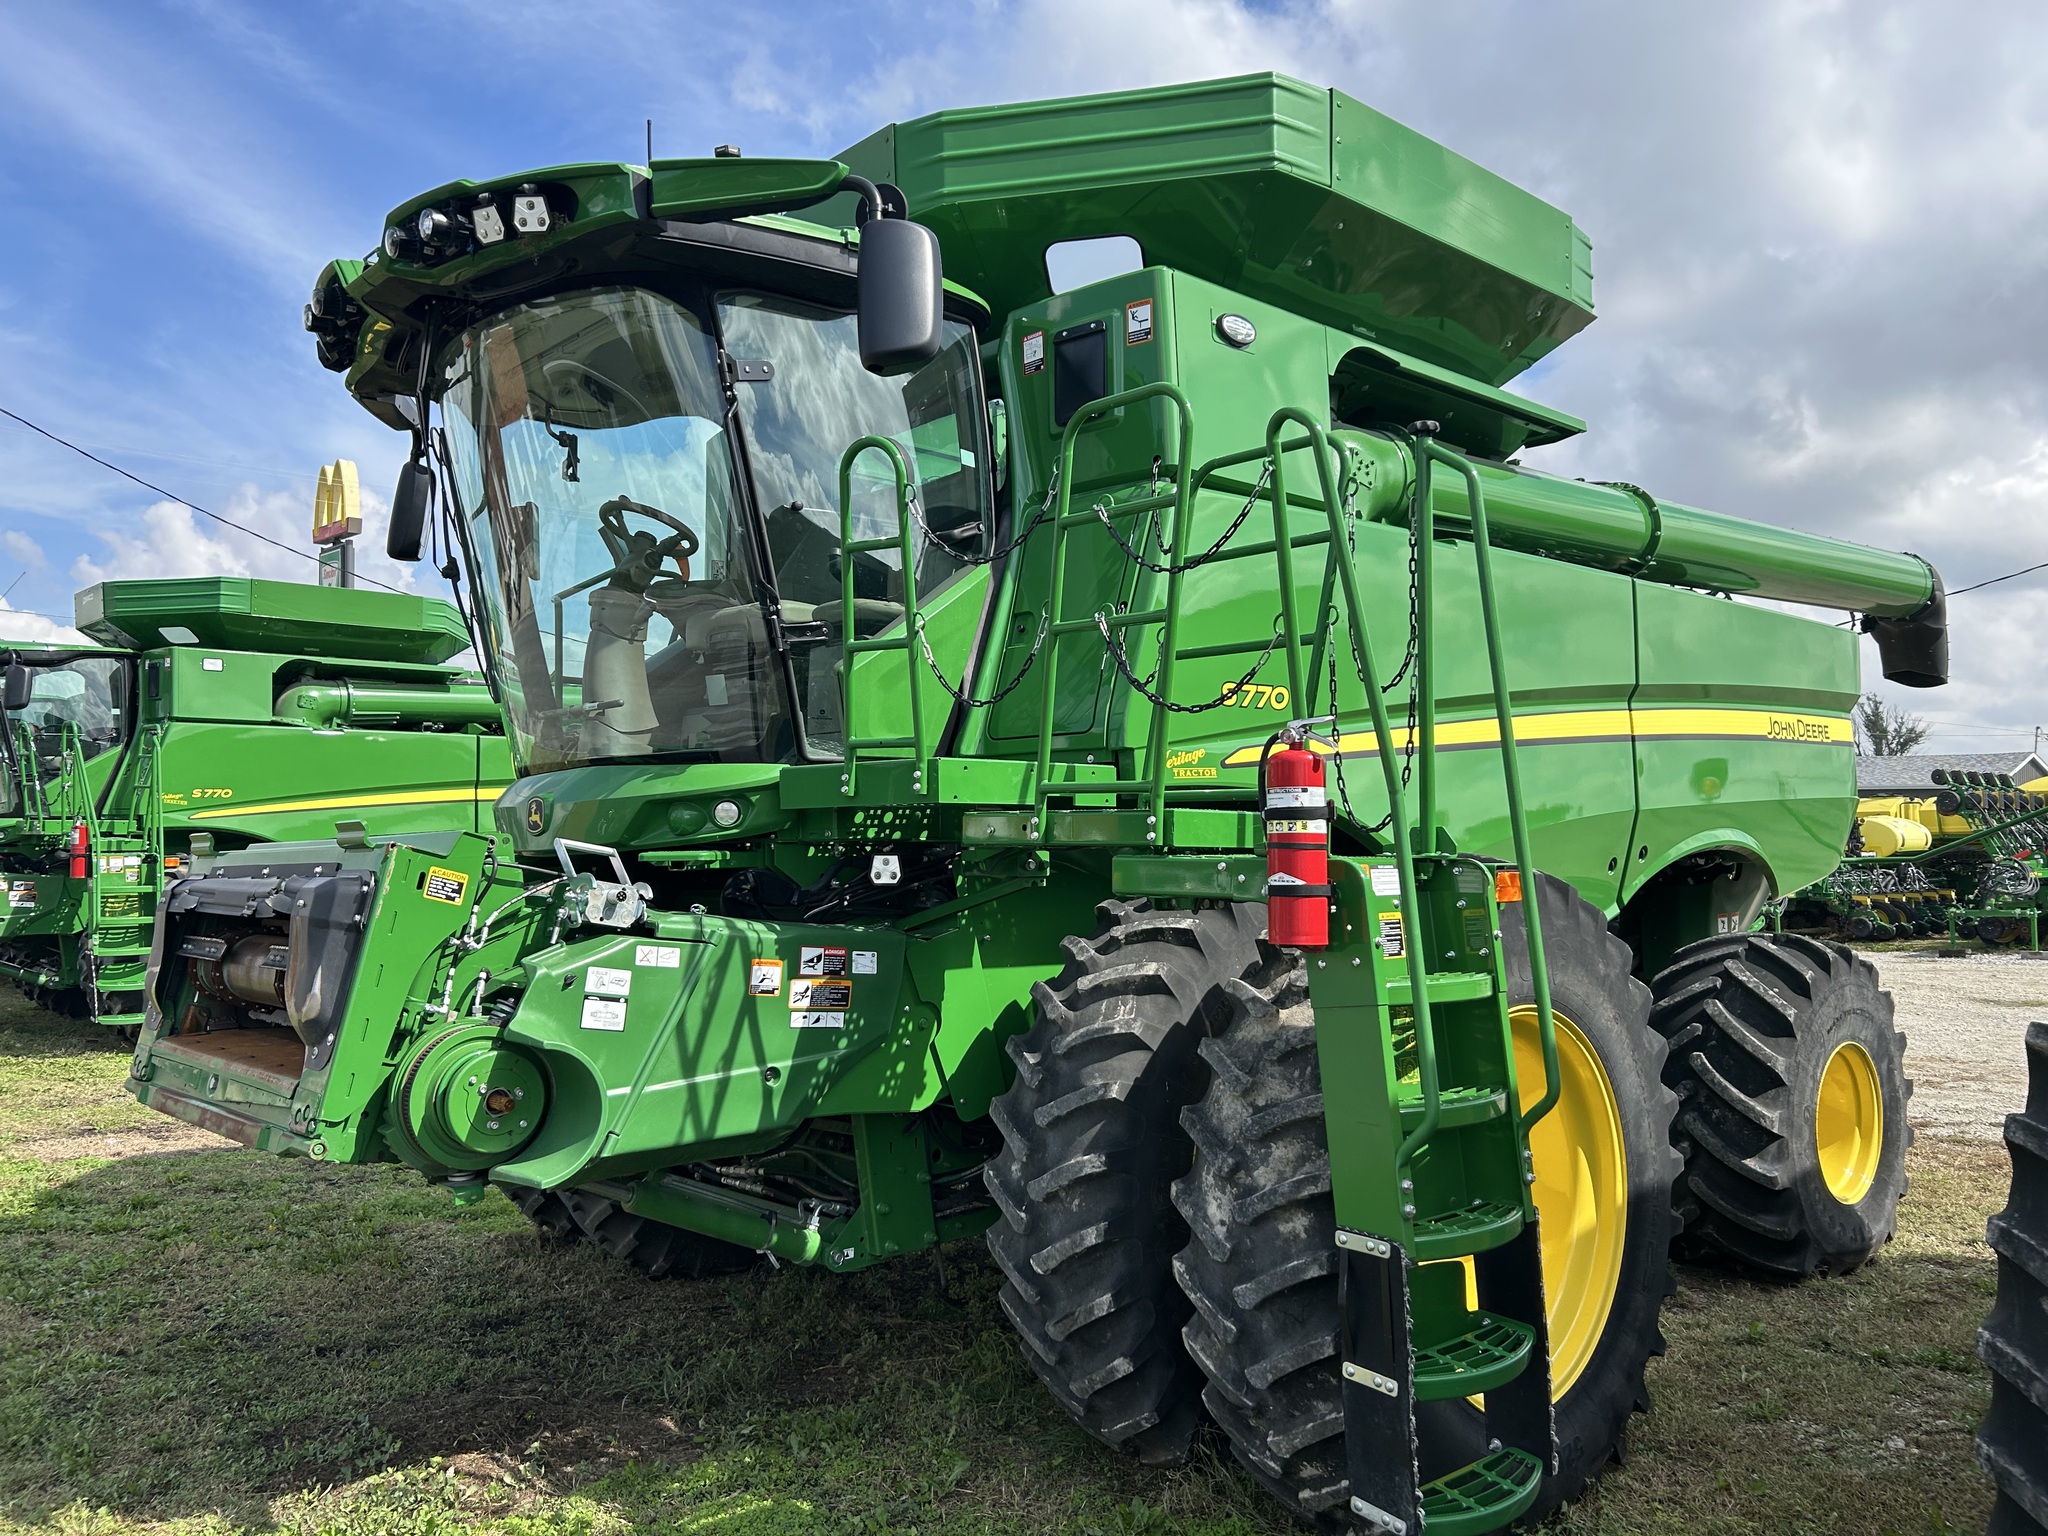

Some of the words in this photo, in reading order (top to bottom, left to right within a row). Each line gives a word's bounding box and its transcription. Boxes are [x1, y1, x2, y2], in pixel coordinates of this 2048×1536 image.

[1221, 681, 1290, 711] S770
[1767, 716, 1796, 738] JOHN
[1797, 719, 1831, 740] DEERE
[1166, 748, 1206, 769] eritage
[1173, 769, 1217, 777] TRACTOR
[191, 788, 233, 799] S770
[437, 869, 467, 881] CAUTION
